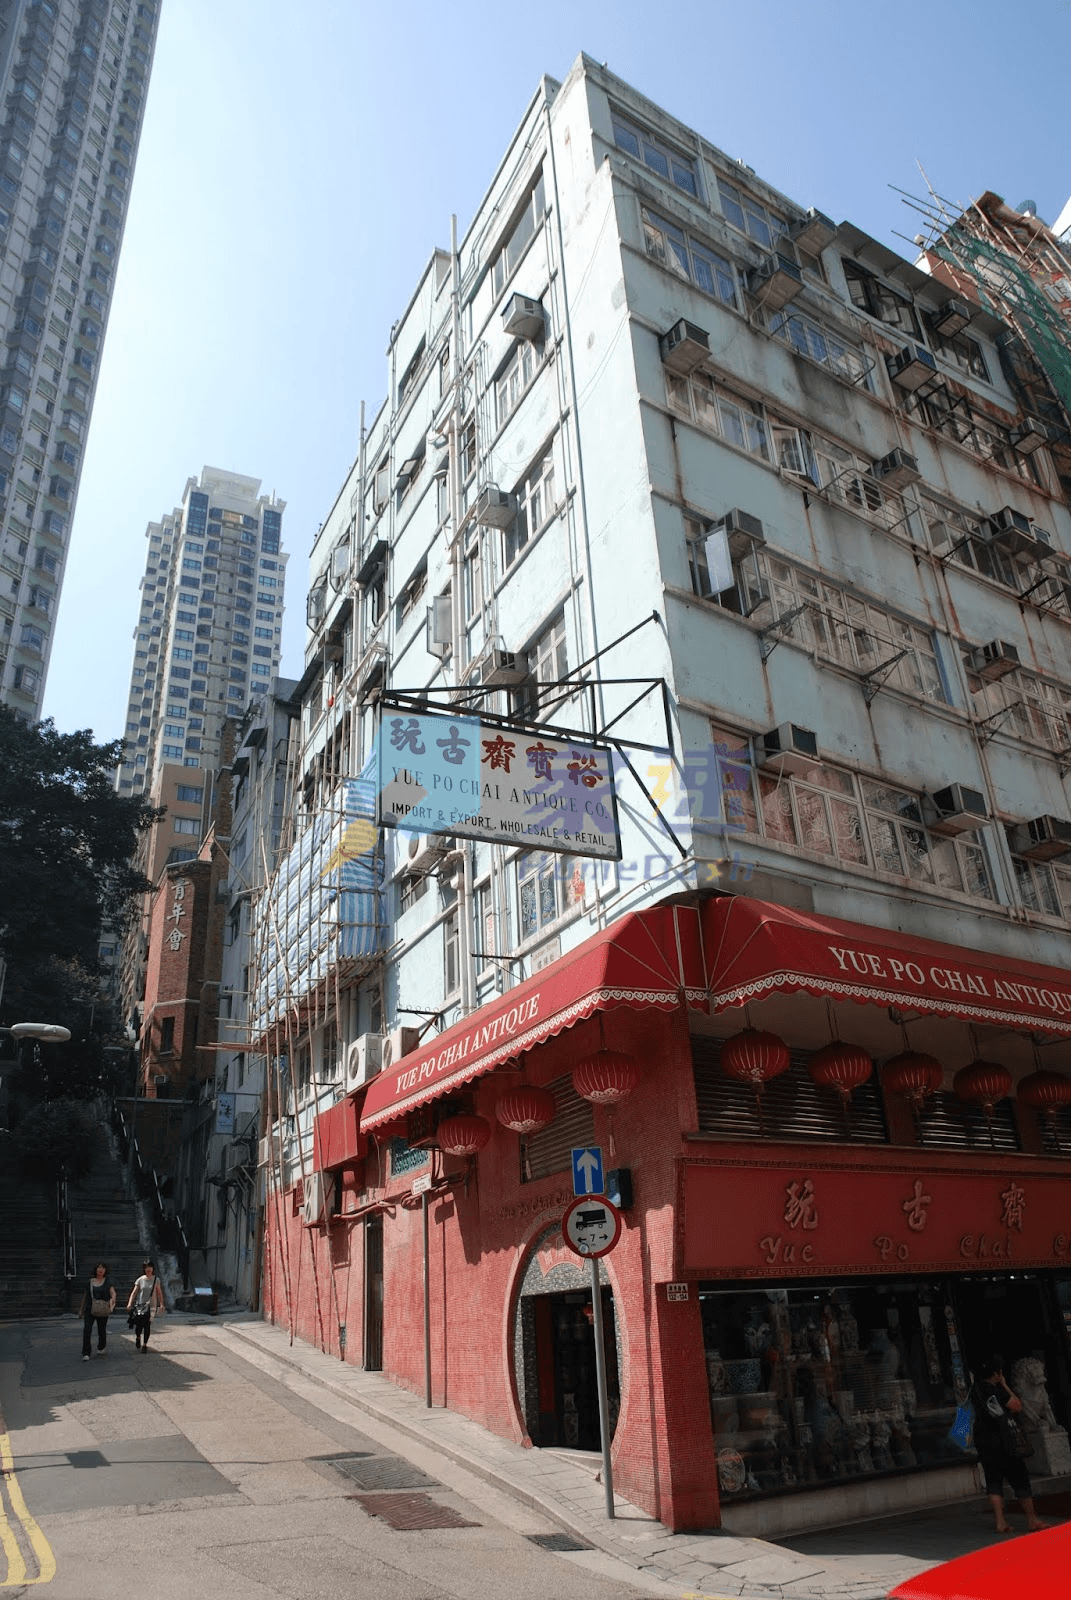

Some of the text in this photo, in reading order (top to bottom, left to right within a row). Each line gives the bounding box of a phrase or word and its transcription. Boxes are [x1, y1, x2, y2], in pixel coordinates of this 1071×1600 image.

[391, 766, 609, 820] YUE PO CHAI ANTIQUE CO.
[391, 802, 433, 821] IMPORT
[437, 810, 446, 821] &
[499, 820, 559, 840] WHOLESALE
[563, 830, 572, 841] &
[574, 831, 608, 847] RETAIL
[165, 877, 191, 951] 青年會
[828, 946, 887, 978] YUE
[887, 957, 926, 985] PO
[929, 967, 991, 998] CHAI
[395, 993, 541, 1094] YUE PO CHAI ANTIQUE
[590, 1233, 596, 1243] 7
[874, 1235, 909, 1261] Po
